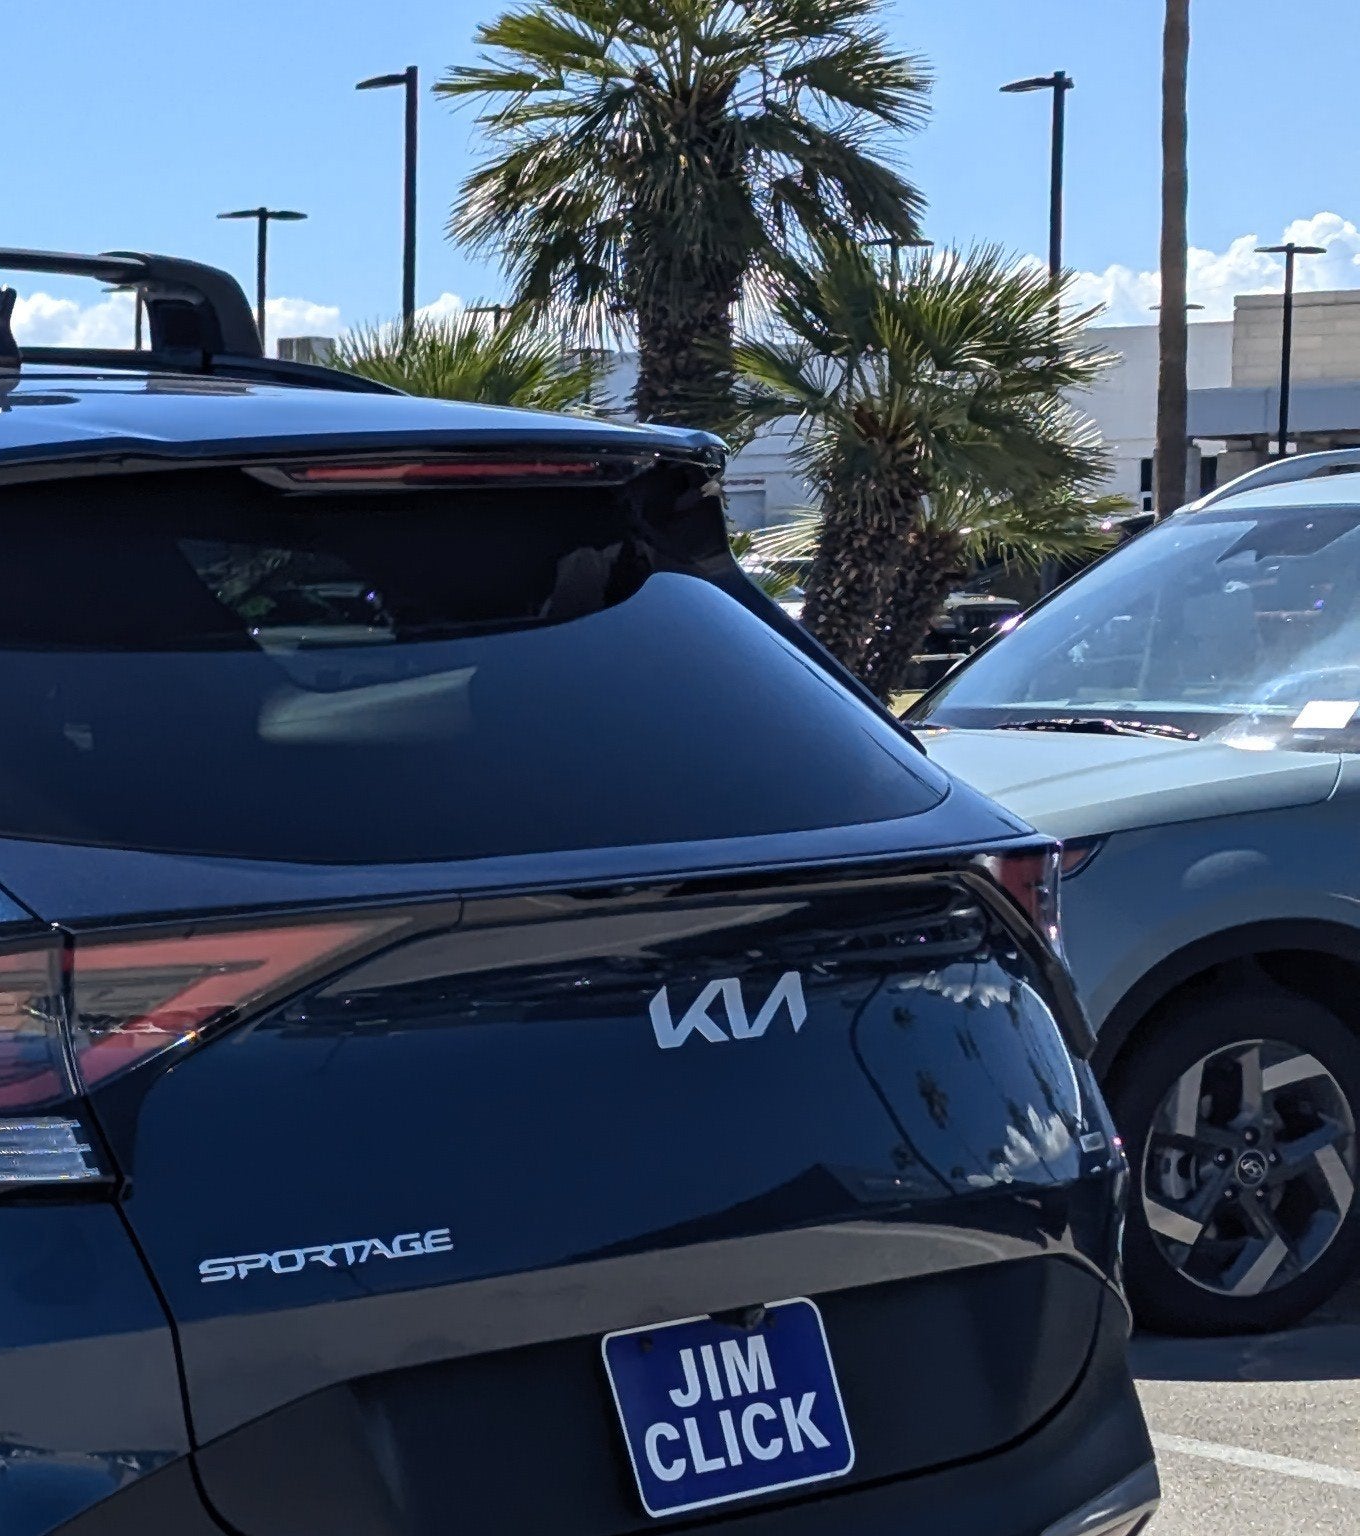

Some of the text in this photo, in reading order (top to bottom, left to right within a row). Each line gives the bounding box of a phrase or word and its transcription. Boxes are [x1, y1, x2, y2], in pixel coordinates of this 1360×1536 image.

[648, 971, 807, 1049] KIA
[198, 1228, 454, 1283] SPORTAGE
[669, 1334, 776, 1407] JIM
[645, 1391, 831, 1482] CLICK
